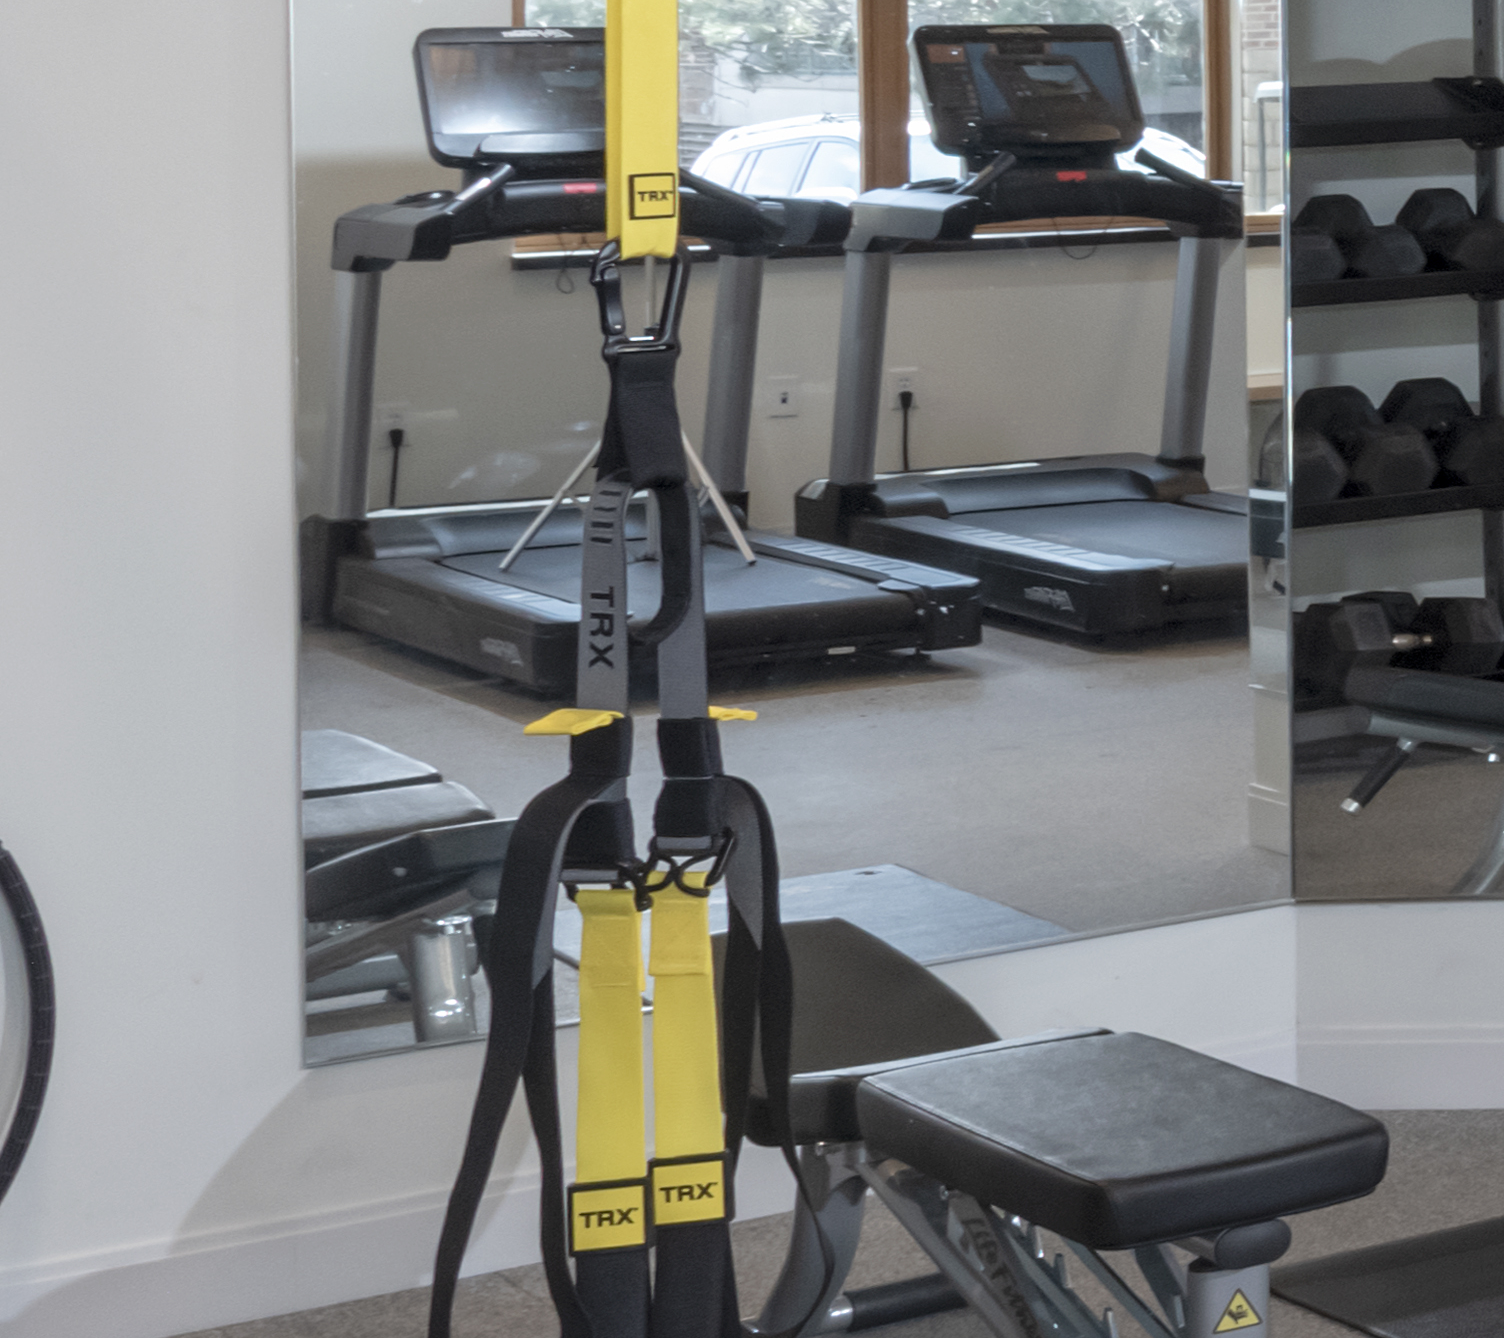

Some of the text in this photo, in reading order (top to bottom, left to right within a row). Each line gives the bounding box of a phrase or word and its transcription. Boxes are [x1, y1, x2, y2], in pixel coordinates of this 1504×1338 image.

[637, 190, 670, 202] TRX
[588, 585, 615, 669] TRX
[659, 1182, 716, 1203] TRX
[578, 1208, 636, 1229] TRX
